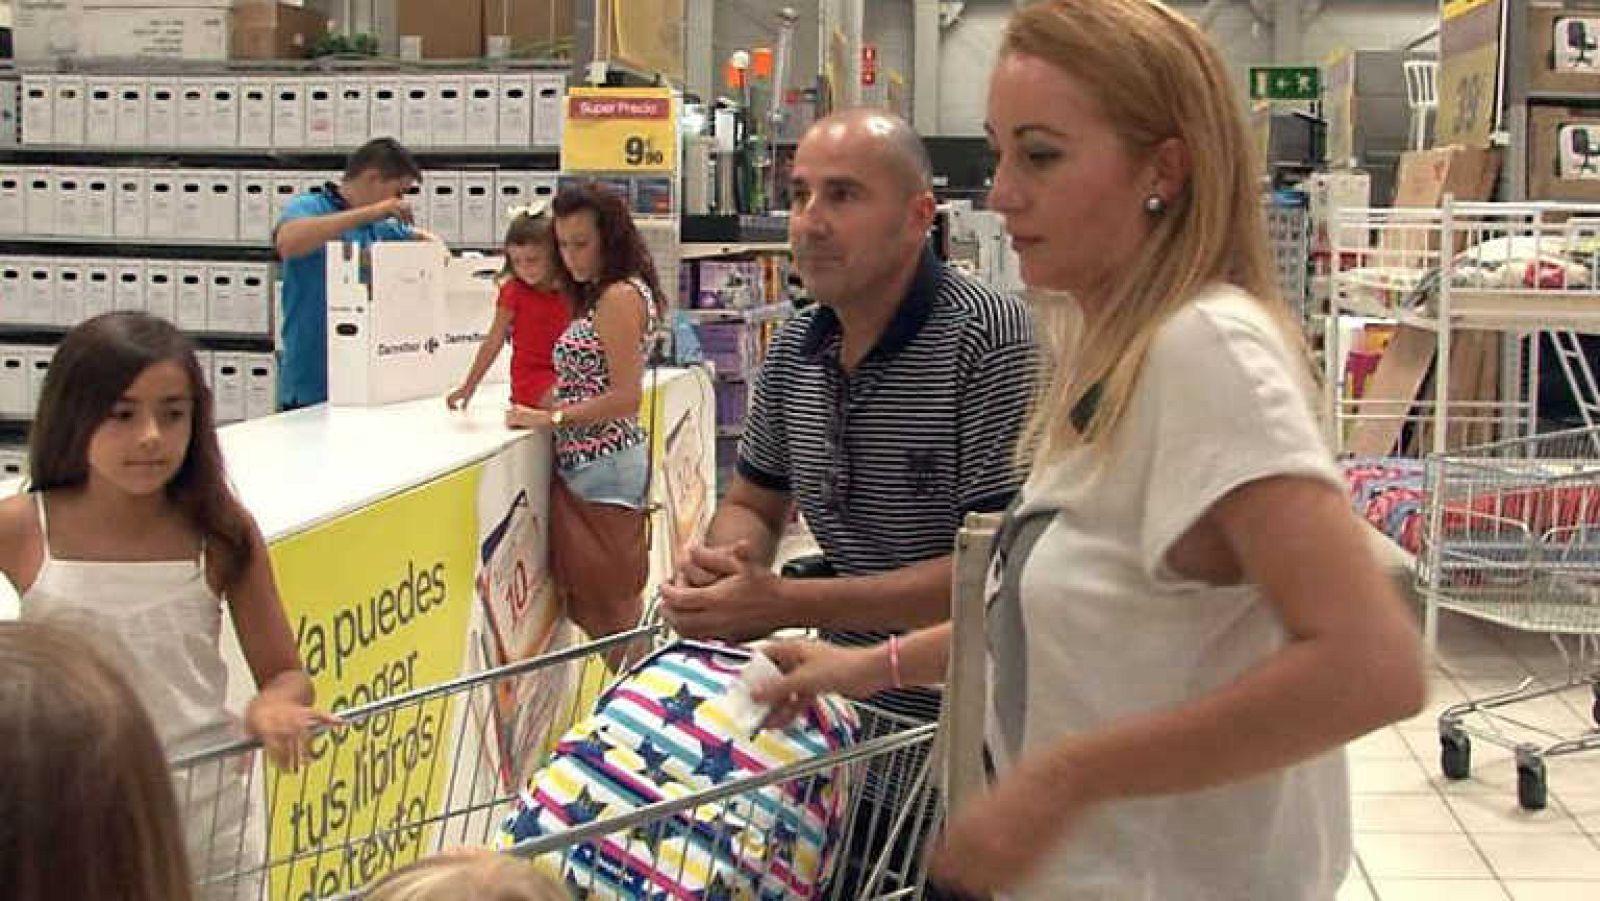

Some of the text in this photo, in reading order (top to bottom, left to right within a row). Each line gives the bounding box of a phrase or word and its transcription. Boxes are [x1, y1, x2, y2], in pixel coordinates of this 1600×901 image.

[579, 101, 658, 114] Super Precio
[333, 560, 446, 680] puedes
[290, 714, 434, 853] tus libros
[342, 796, 427, 890] texto
